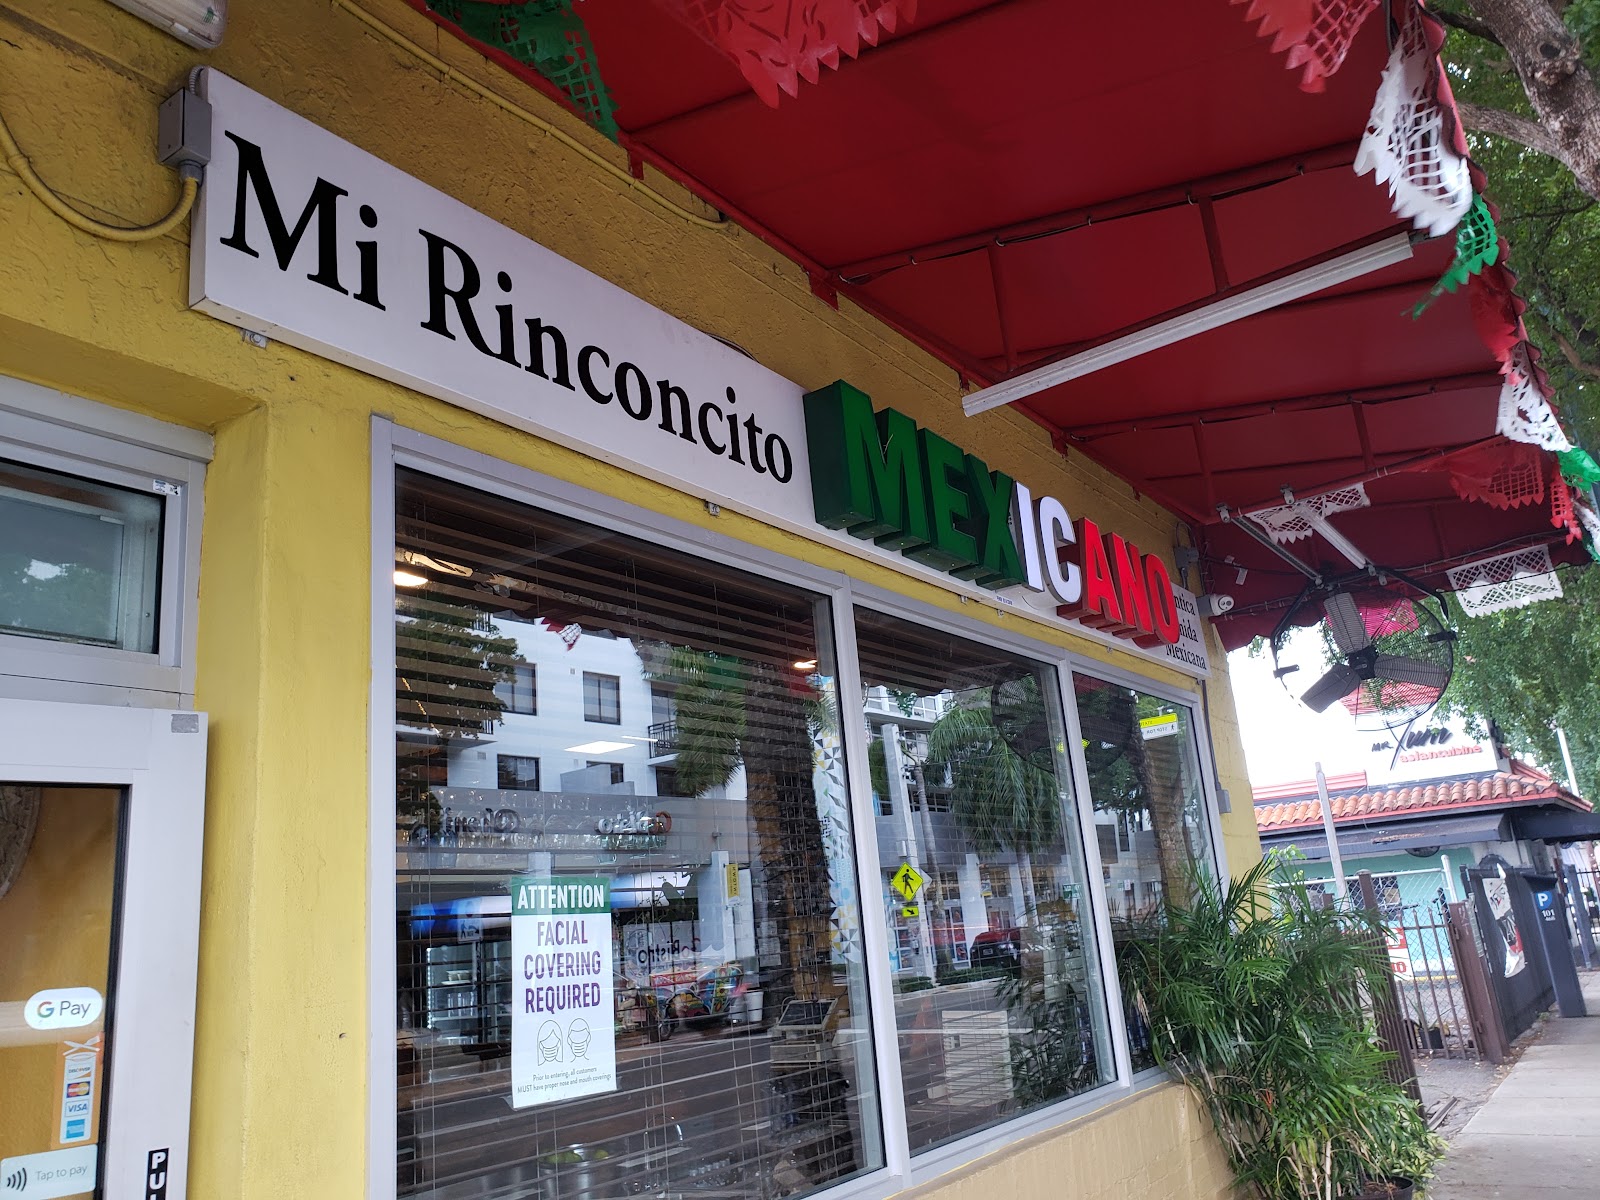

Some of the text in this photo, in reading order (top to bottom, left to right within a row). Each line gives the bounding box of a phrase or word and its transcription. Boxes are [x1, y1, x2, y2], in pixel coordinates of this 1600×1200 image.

[220, 130, 793, 483] Mi Rinconcito
[805, 380, 1180, 648] MEXICANO
[1166, 644, 1207, 670] Mexicana
[517, 884, 604, 909] ATTENTION
[1538, 893, 1548, 906] P
[537, 920, 588, 947] FACIAL
[524, 950, 601, 980] COVERING
[59, 1000, 92, 1019] Pay
[525, 982, 601, 1014] REQUIRED
[518, 1084, 532, 1094] MUST
[544, 1081, 559, 1092] proper
[579, 1076, 592, 1084] mouth
[592, 1073, 612, 1082] coverings
[532, 1074, 544, 1082] Prior
[550, 1070, 570, 1079] entering,
[576, 1066, 598, 1074] customers
[67, 1102, 88, 1113] VISA
[36, 1164, 88, 1183] Tap to pay
